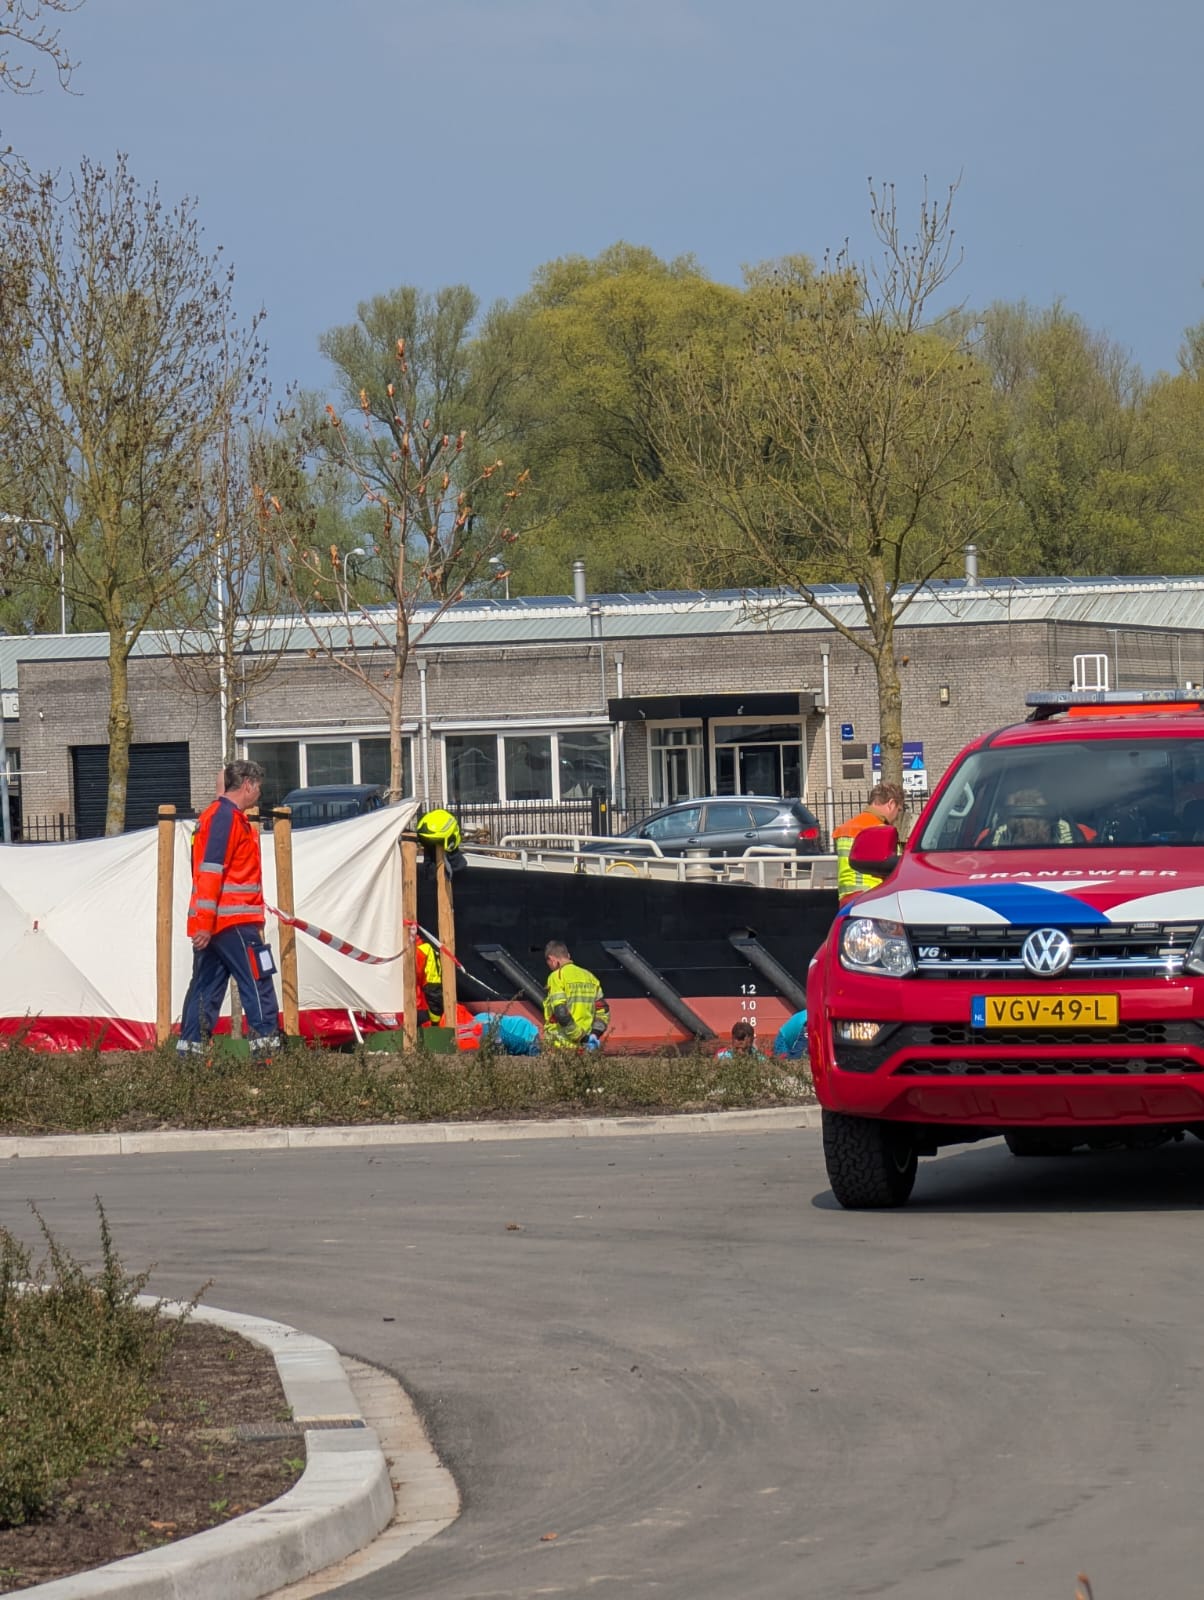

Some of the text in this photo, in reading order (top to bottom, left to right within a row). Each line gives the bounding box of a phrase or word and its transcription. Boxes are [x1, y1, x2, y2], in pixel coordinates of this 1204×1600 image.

[968, 870, 1179, 880] BRANDWEER
[918, 946, 940, 958] V6
[992, 1000, 1107, 1022] VGV-49-L
[974, 1013, 985, 1021] NL
